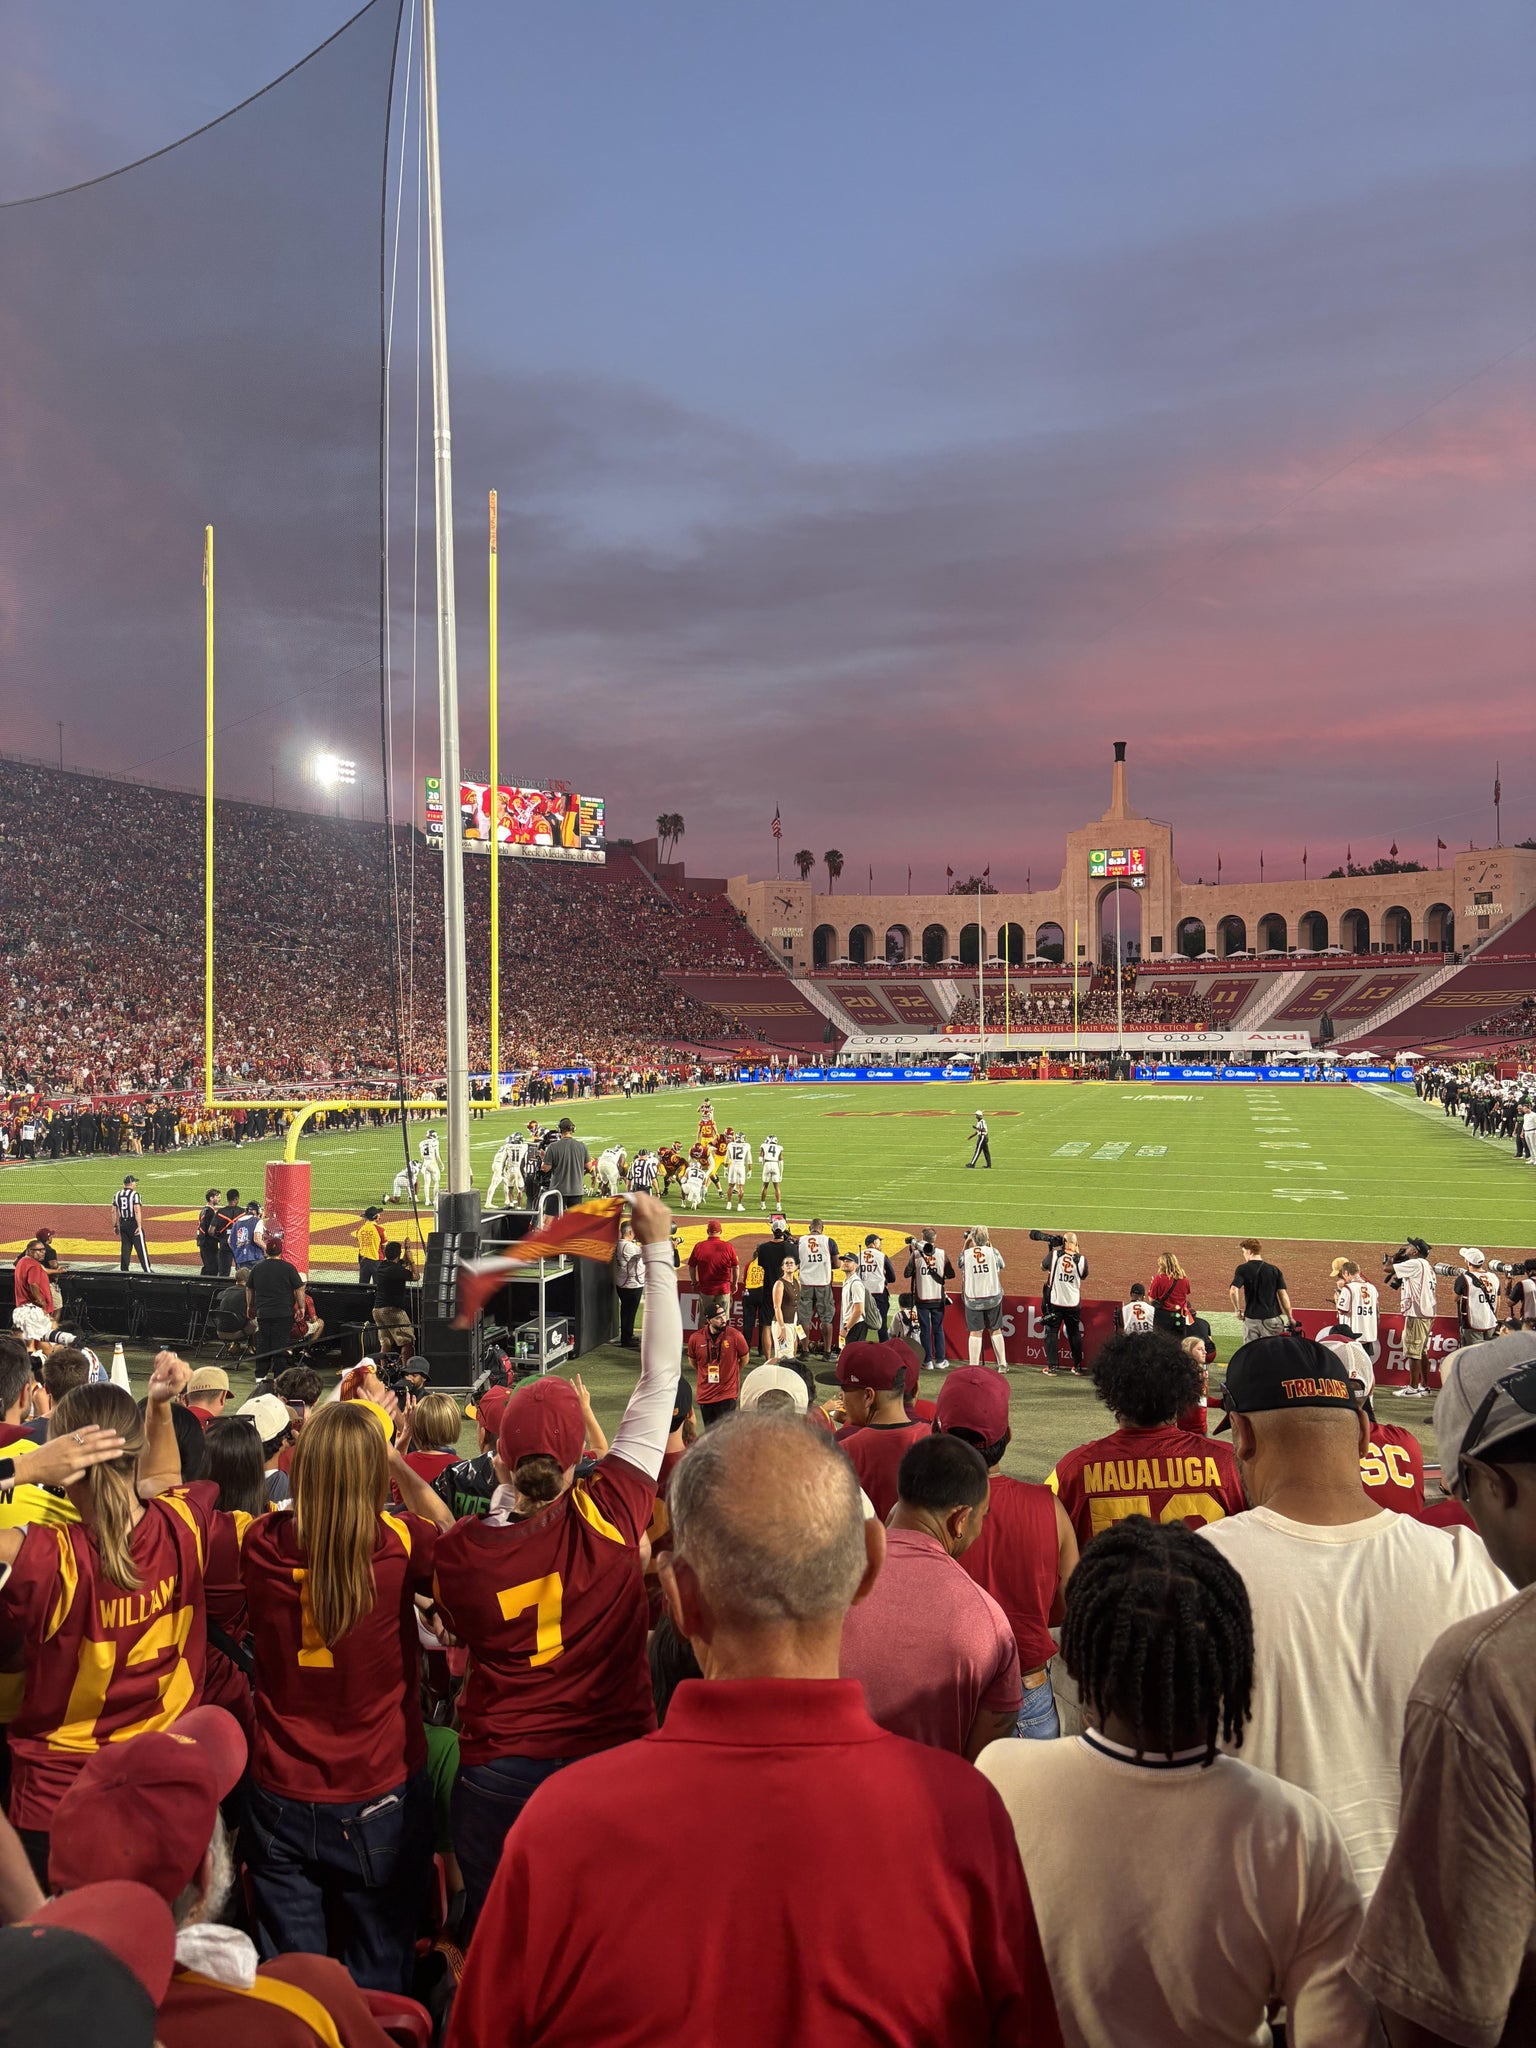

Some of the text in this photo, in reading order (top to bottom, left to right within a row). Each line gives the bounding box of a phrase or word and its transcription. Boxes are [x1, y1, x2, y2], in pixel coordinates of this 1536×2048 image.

[499, 772, 534, 787] edicine
[521, 846, 540, 857] Keck
[542, 849, 575, 860] Medicine
[1092, 865, 1105, 874] 20
[1132, 864, 1144, 872] 16
[1213, 991, 1238, 1003] 11
[1309, 989, 1335, 1001] 5
[1357, 987, 1394, 1000] 13
[841, 996, 877, 1008] 20
[892, 996, 928, 1007] 32
[1129, 1024, 1152, 1032] BAND
[701, 1125, 712, 1135] 45
[423, 1144, 430, 1156] 3
[510, 1149, 520, 1162] 11
[732, 1146, 744, 1160] 12
[768, 1145, 777, 1157] 4
[635, 1166, 642, 1178] S
[110, 1196, 118, 1210] B
[807, 1237, 819, 1254] SC
[807, 1253, 823, 1263] 113
[973, 1247, 986, 1264] SC
[972, 1264, 989, 1274] 115
[1061, 1256, 1074, 1274] SC
[1058, 1273, 1075, 1284] 102
[1133, 1304, 1145, 1320] SC
[1356, 1305, 1373, 1316] 064
[1132, 1321, 1149, 1331] 118
[1026, 1345, 1041, 1359] by
[1282, 1378, 1350, 1400] TROJANS
[1083, 1456, 1222, 1494] MAUALUGA
[496, 1571, 565, 1668] 7
